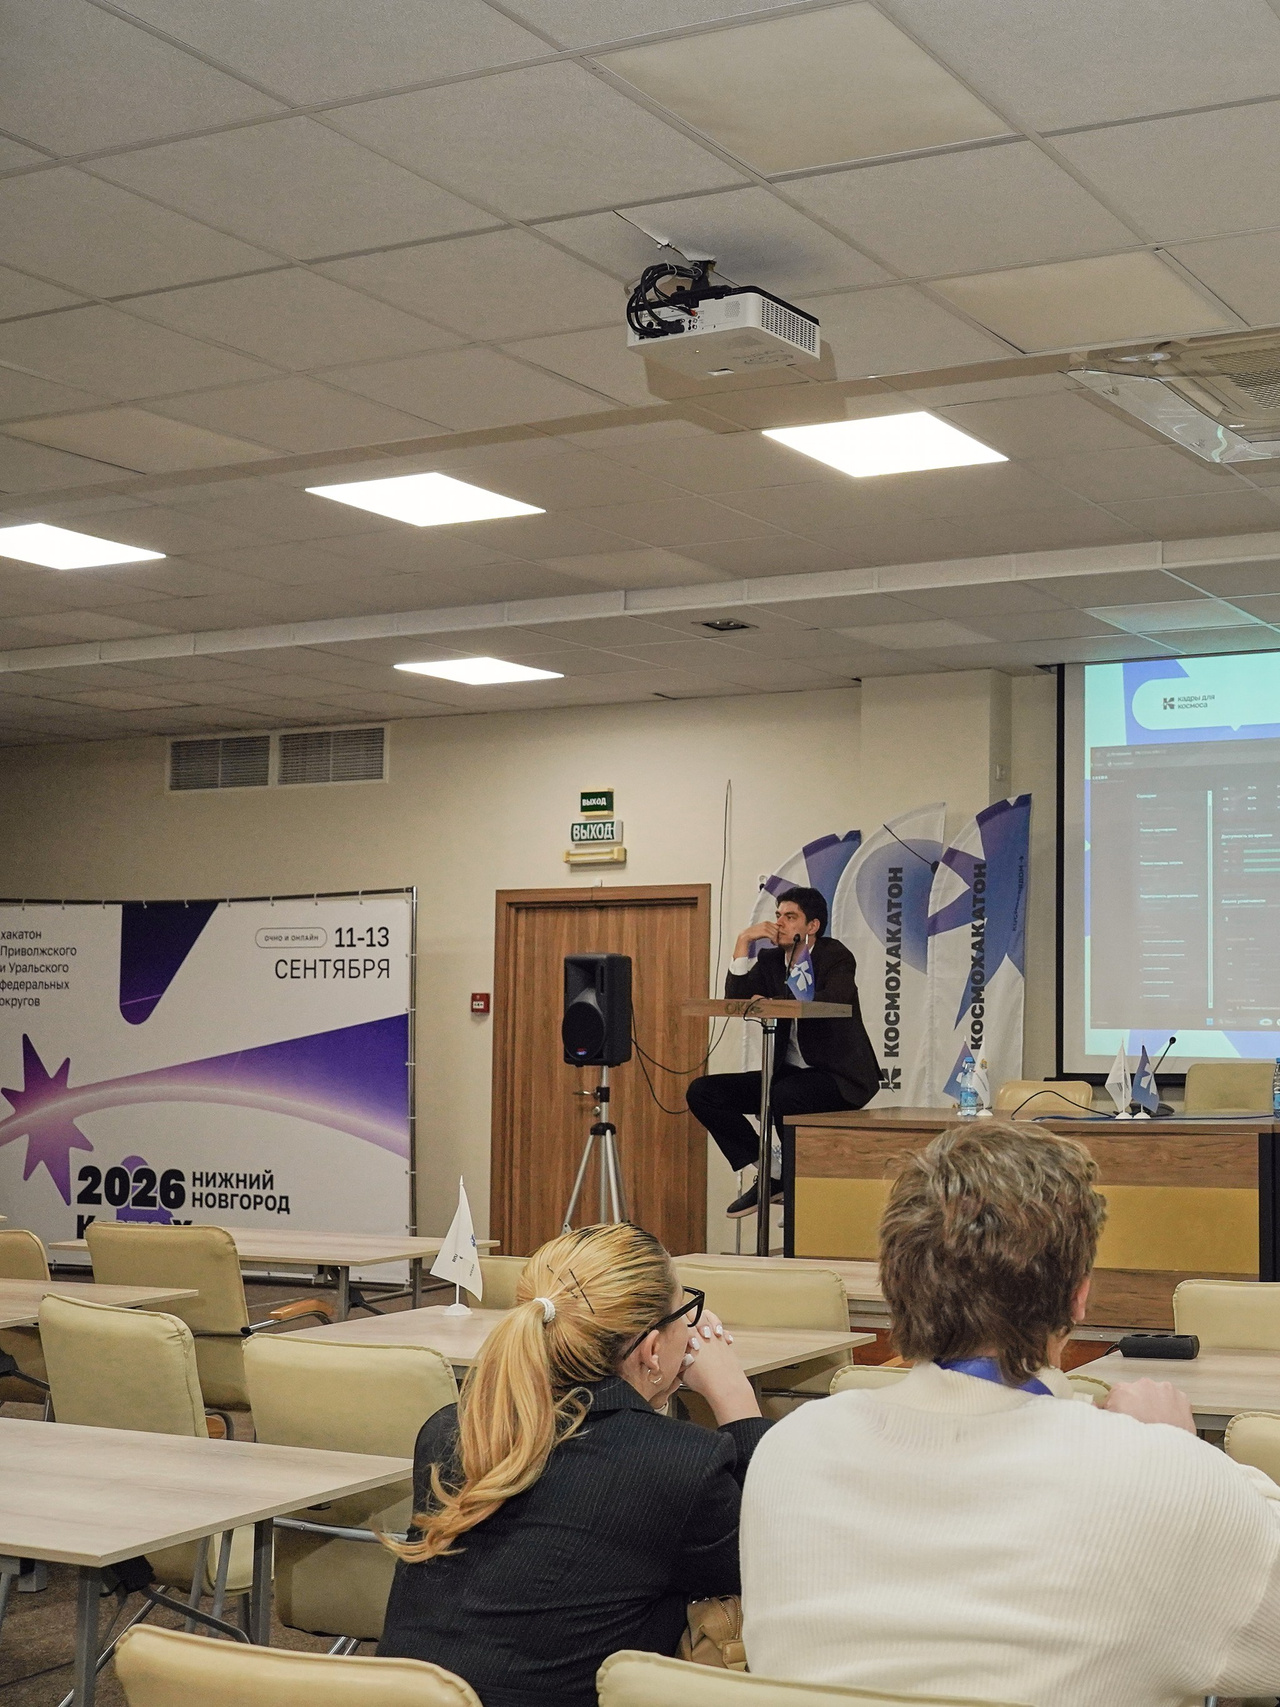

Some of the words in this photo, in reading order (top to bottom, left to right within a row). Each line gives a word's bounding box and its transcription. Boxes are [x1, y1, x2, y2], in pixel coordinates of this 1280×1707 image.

[1177, 696, 1201, 705] кадры
[1202, 694, 1216, 702] для
[1177, 702, 1208, 710] космоса
[582, 797, 607, 806] ВЫХОД
[573, 823, 613, 840] ВЫХОД
[0, 930, 42, 940] хакатон
[335, 926, 389, 948] 11-13
[0, 945, 77, 959] Приволжского
[970, 863, 987, 1050] КОСМОХАКАТОН
[9, 962, 69, 976] Уральского
[274, 958, 390, 979] СЕНТЯБРЯ
[884, 867, 903, 1057] КОСМОХАКАТОН
[0, 979, 70, 992] федеральных
[0, 997, 41, 1009] округов
[77, 1165, 186, 1209] 2026
[192, 1169, 274, 1190] НИЖНИЙ
[192, 1192, 290, 1215] НОВГОРОД
